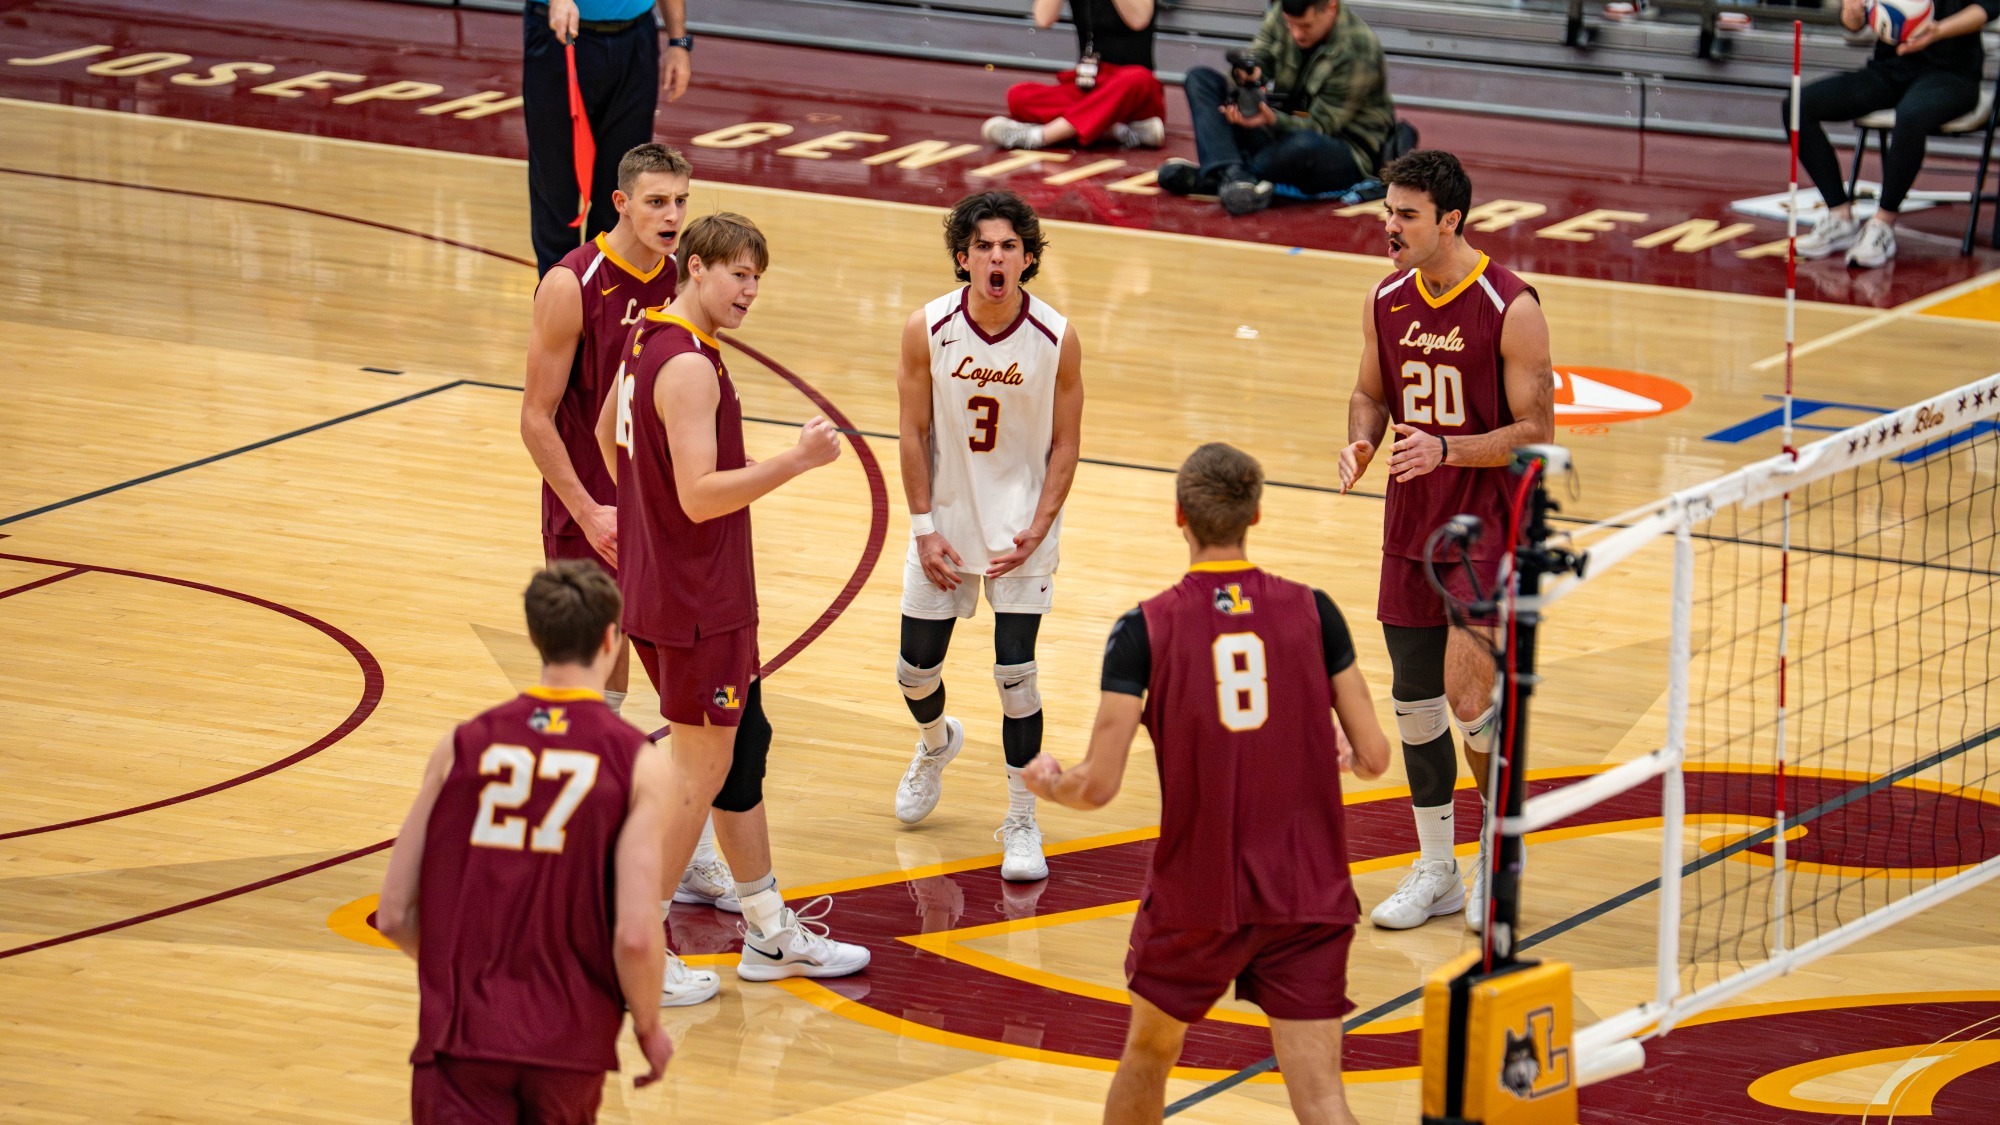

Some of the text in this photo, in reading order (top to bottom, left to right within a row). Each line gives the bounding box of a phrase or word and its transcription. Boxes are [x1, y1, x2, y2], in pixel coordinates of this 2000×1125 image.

[7, 44, 524, 120] JOSEPH
[692, 120, 1222, 203] GENTIL
[951, 355, 1024, 388] Loyola
[1399, 320, 1465, 355] Loyola
[966, 394, 1000, 453] 3
[1401, 359, 1466, 427] 20
[1212, 631, 1269, 733] 8
[470, 743, 600, 854] 27
